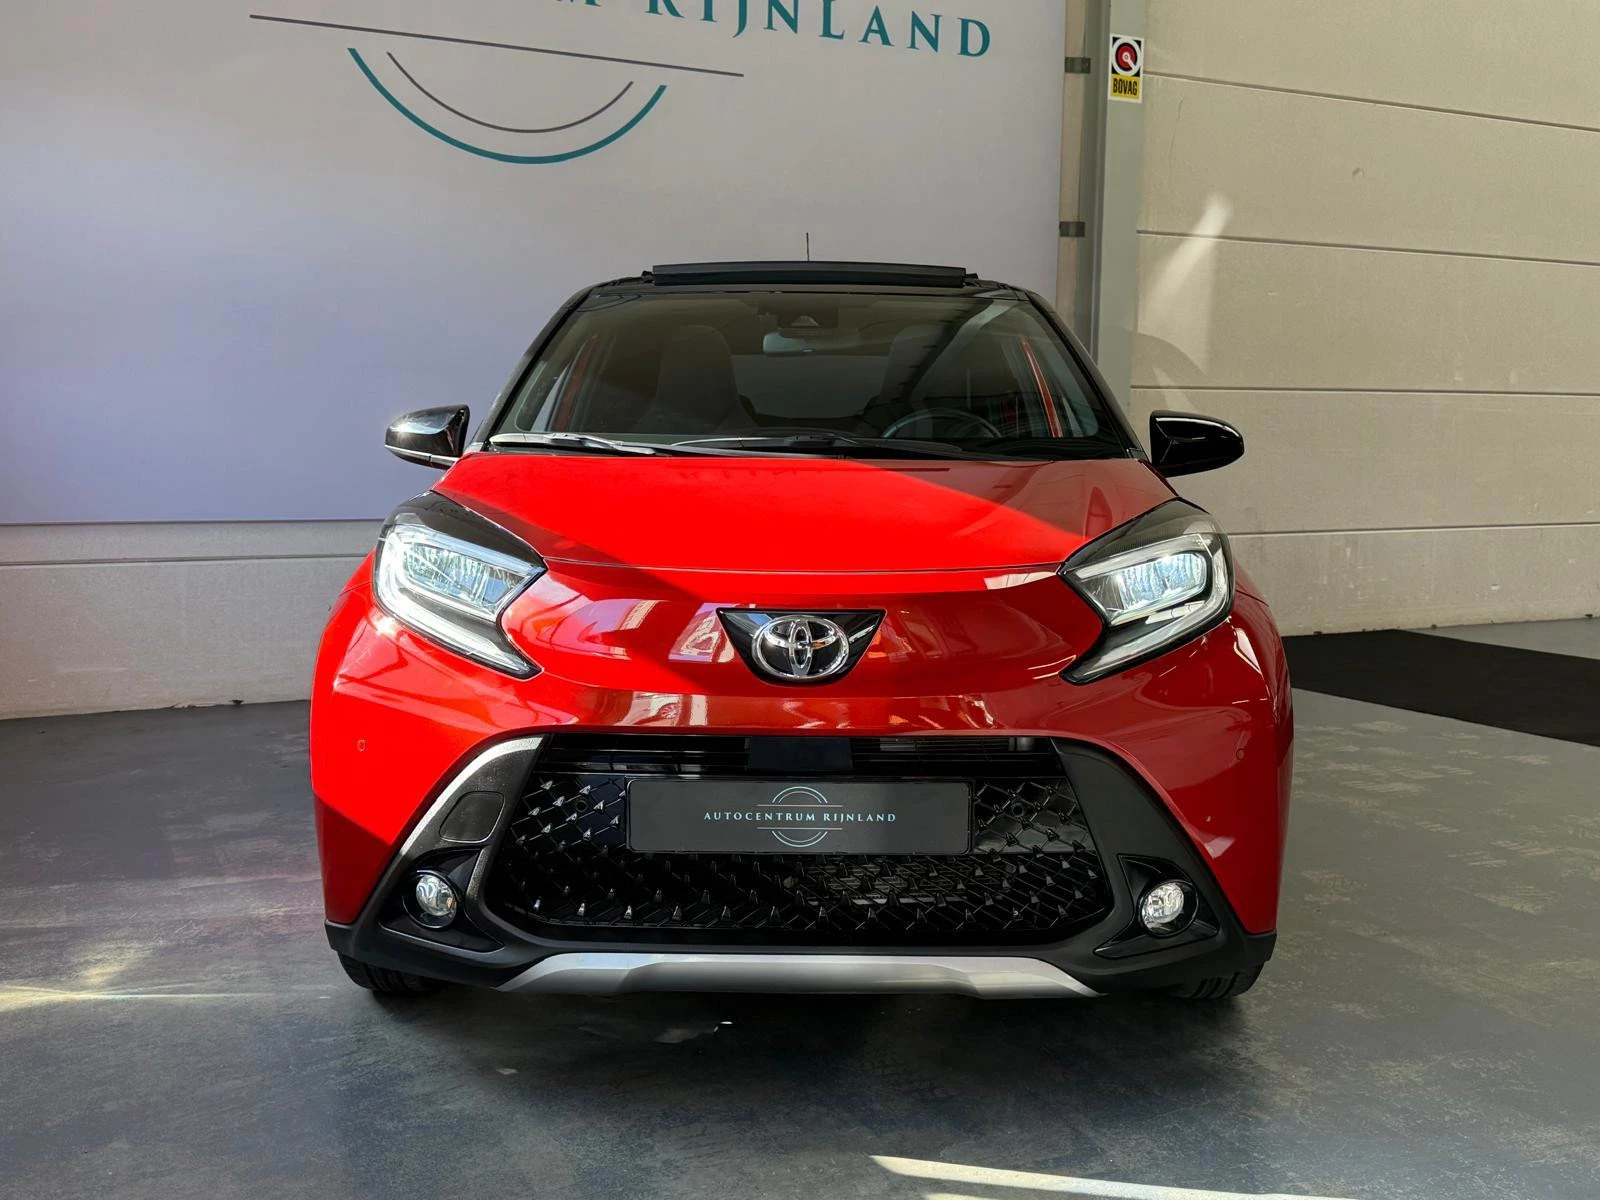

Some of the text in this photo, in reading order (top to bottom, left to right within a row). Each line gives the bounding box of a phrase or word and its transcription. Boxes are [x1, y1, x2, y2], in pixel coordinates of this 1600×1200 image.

[1112, 78, 1138, 96] BOVAG
[703, 811, 897, 823] AUTOCENTRUM RIJNLAND
